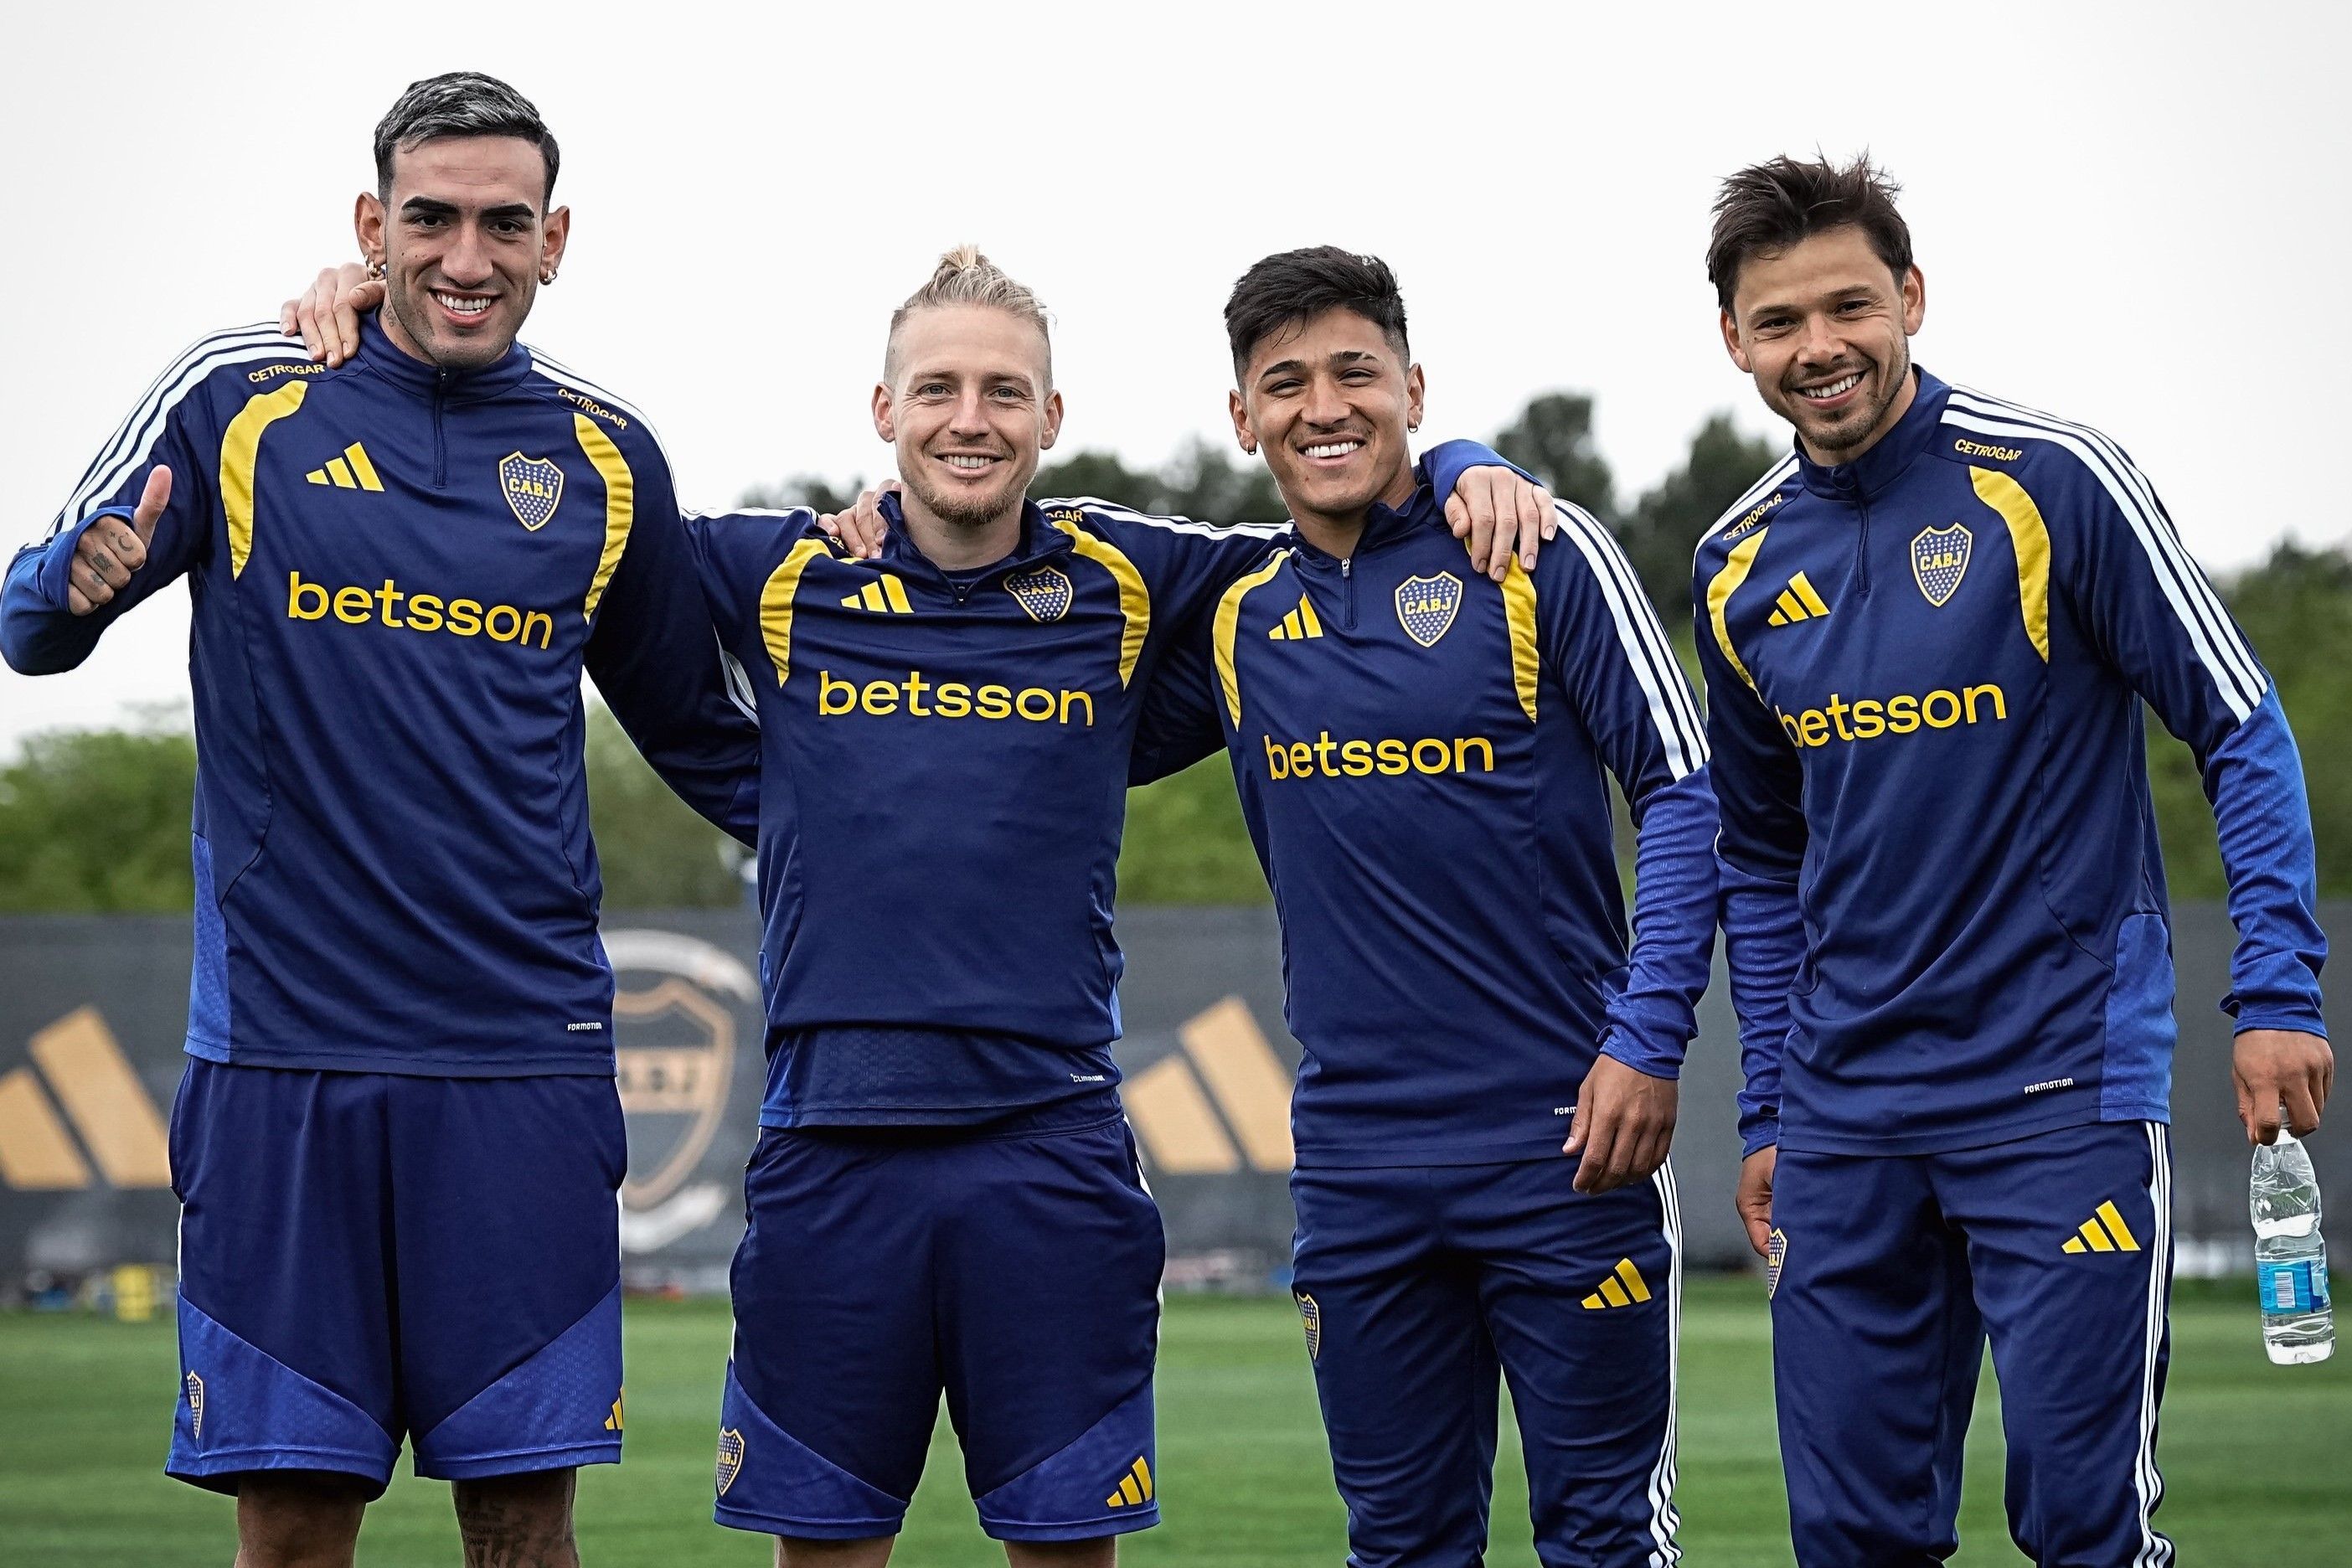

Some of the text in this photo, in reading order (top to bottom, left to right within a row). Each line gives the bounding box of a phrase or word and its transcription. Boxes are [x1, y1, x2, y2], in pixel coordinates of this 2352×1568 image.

[248, 364, 325, 383] CETROGAR
[558, 388, 628, 431] CETROGAR
[1954, 438, 2023, 462] CETROGAR
[508, 477, 554, 500] CABJ
[1722, 493, 1783, 541] CETROGAR
[1920, 550, 1963, 571] CABJ
[287, 571, 554, 650] betsson
[1405, 596, 1452, 615] CABJ
[818, 670, 1094, 726] betsson
[1774, 683, 2007, 748] betsson
[1263, 730, 1494, 780] betsson
[2024, 1077, 2074, 1094] FORMOTION
